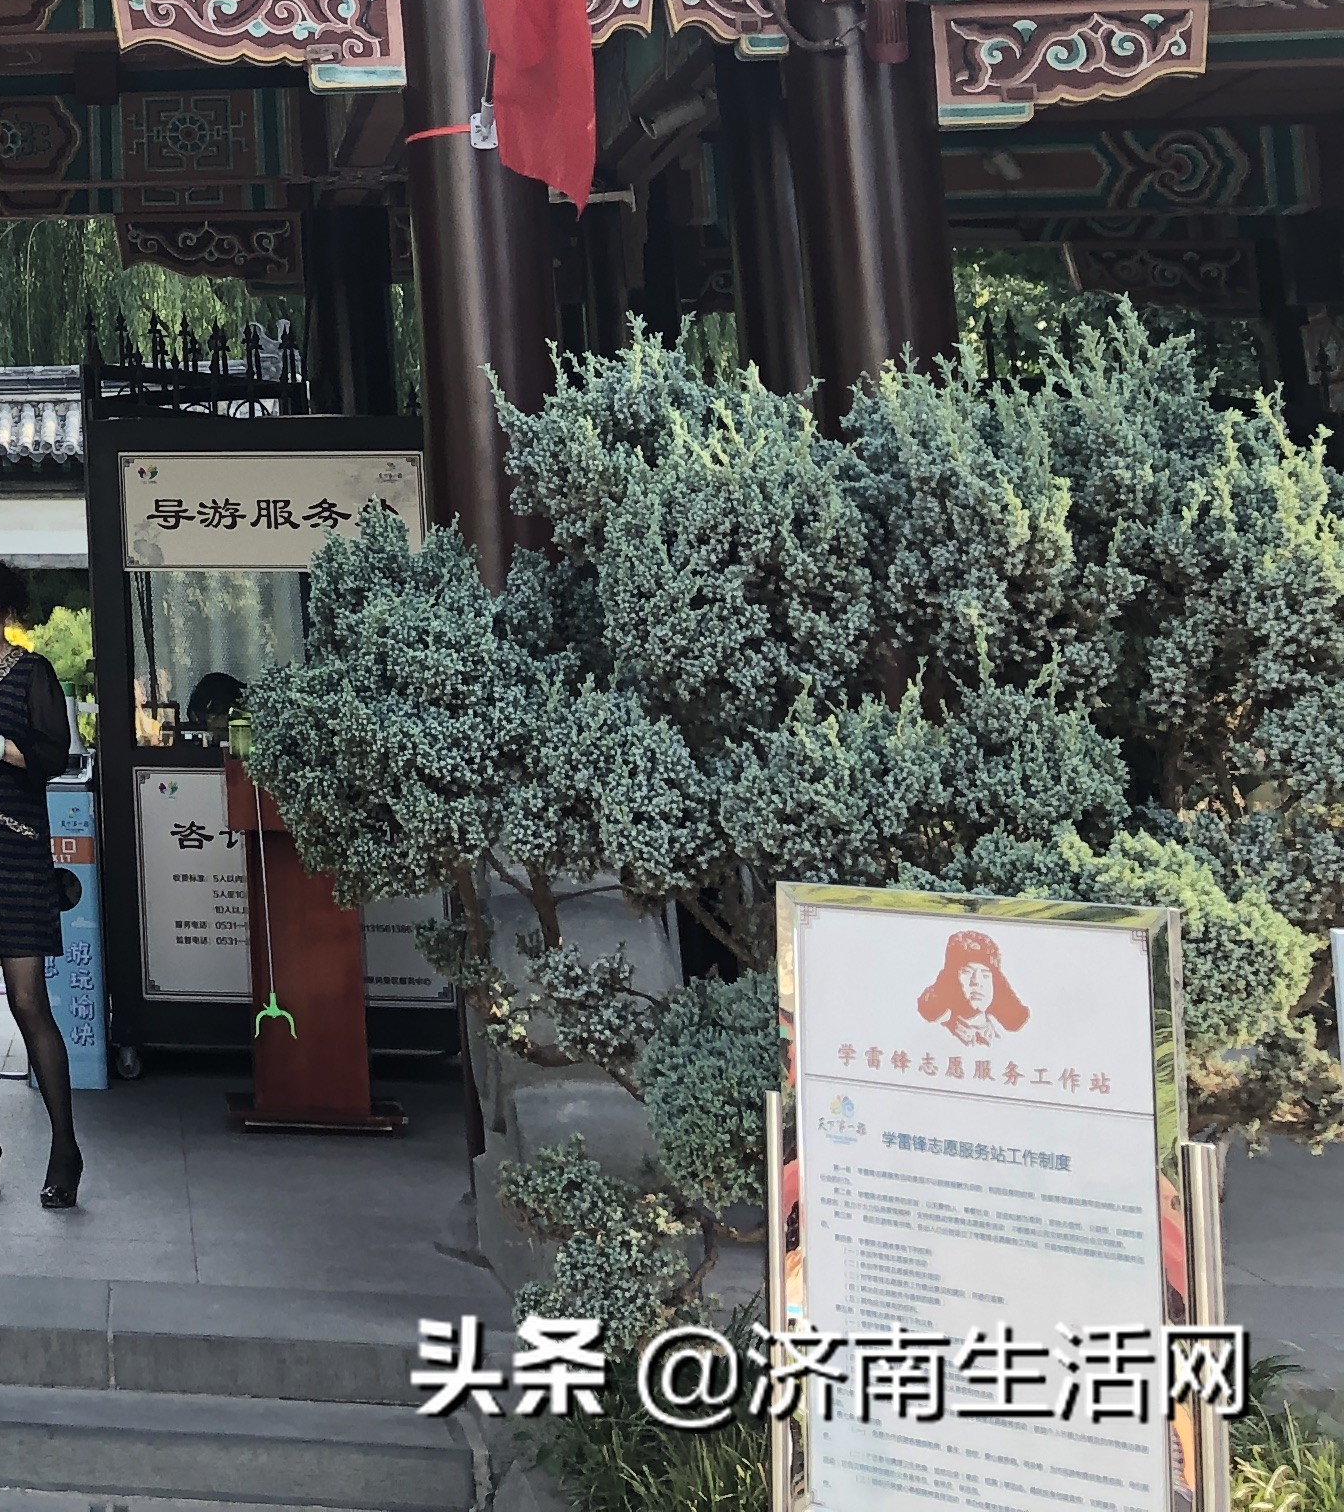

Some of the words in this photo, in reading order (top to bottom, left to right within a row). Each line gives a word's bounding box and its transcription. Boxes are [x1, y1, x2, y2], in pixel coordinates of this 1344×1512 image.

[52, 854, 71, 863] XIT
[66, 940, 95, 1047] 游玩愉快
[837, 1043, 1113, 1095] 学雷锋志愿服务工作站
[881, 1130, 1073, 1172] 学雷锋志愿服务站工作制度
